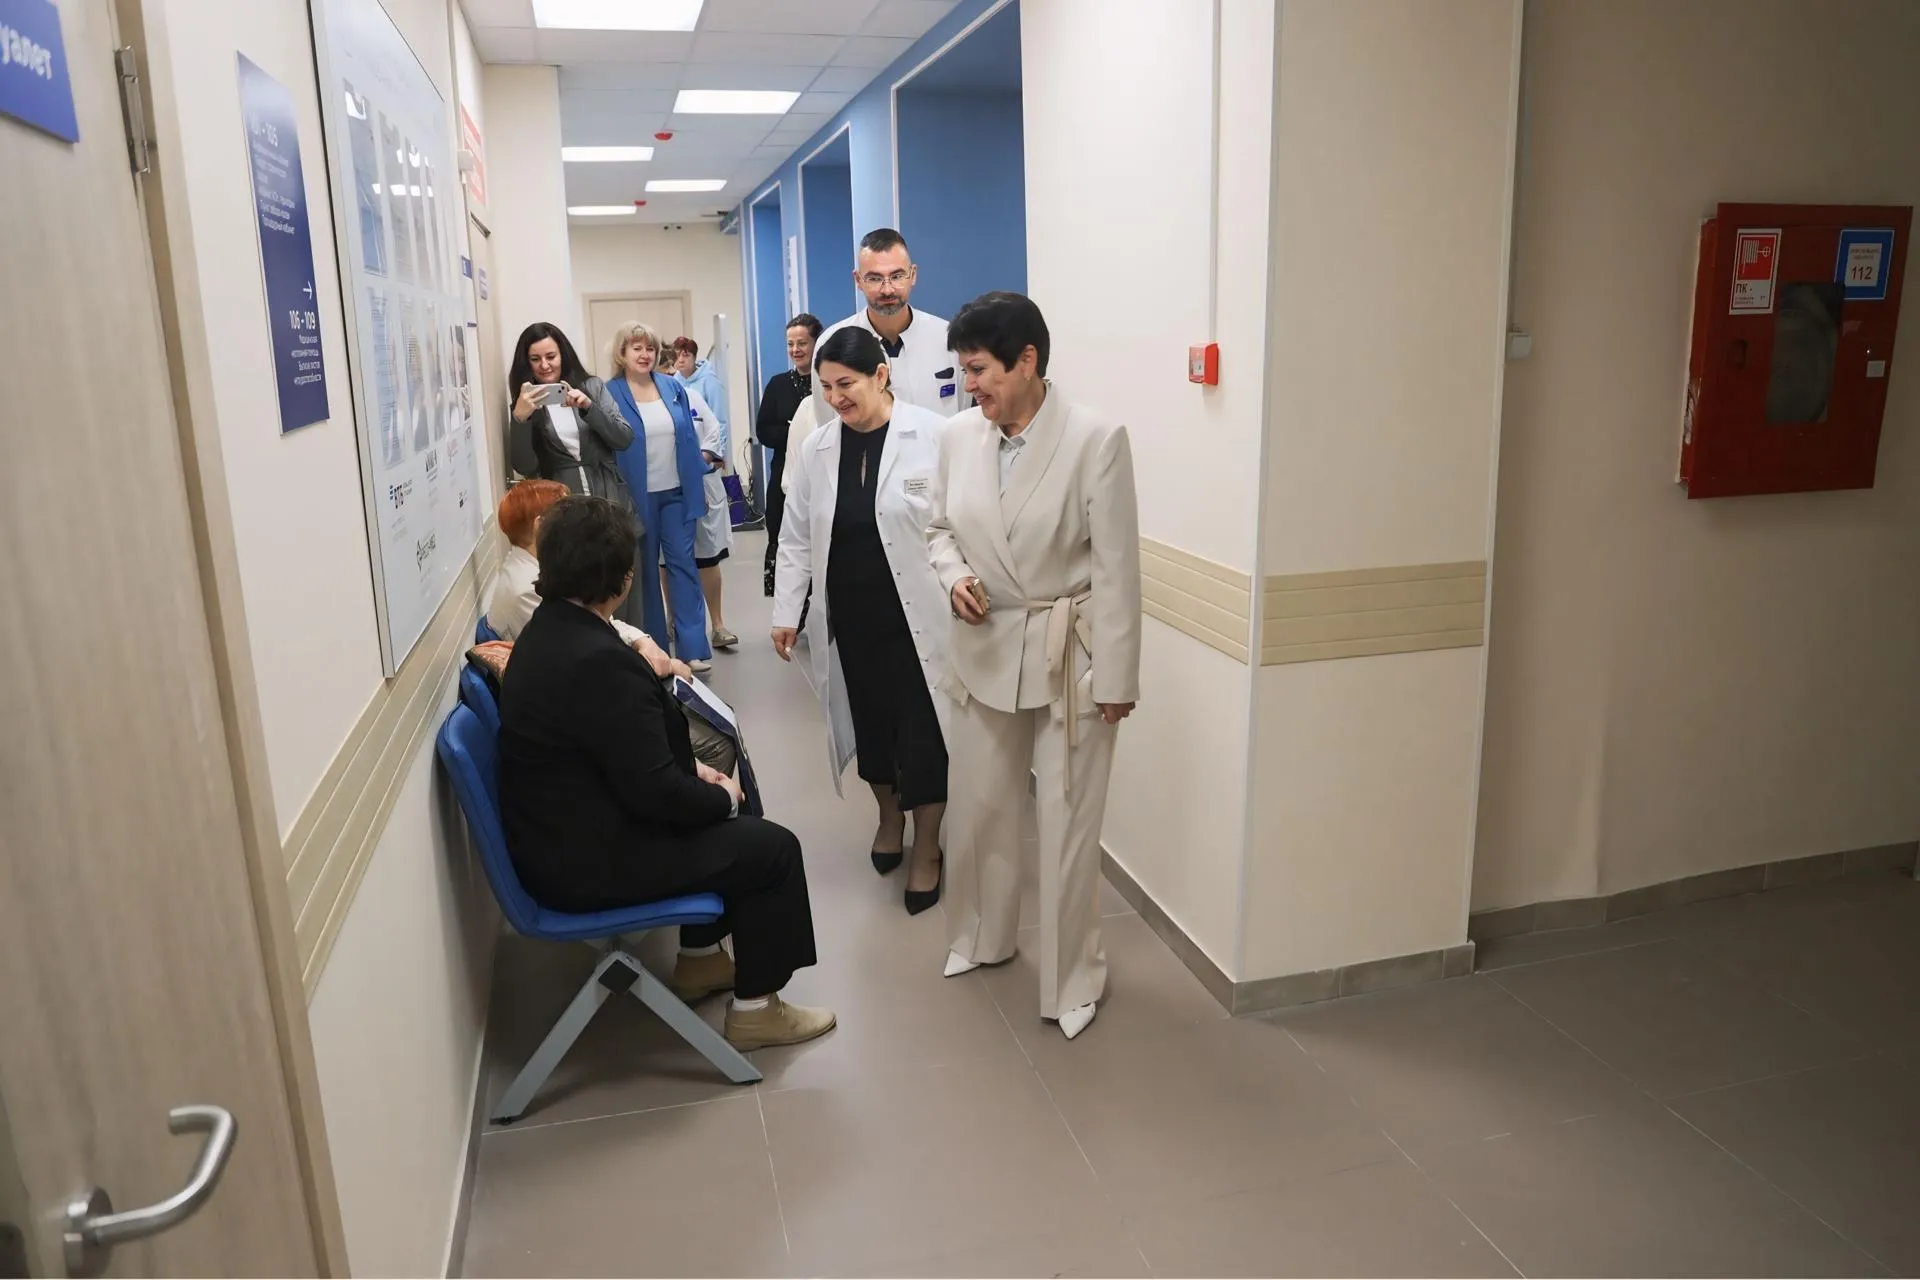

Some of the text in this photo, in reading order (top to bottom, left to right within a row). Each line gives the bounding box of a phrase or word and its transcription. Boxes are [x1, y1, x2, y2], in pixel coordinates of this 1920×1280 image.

[1851, 265, 1873, 280] 112
[1736, 284, 1748, 294] ПК
[289, 310, 300, 330] 106
[304, 311, 316, 330] 109
